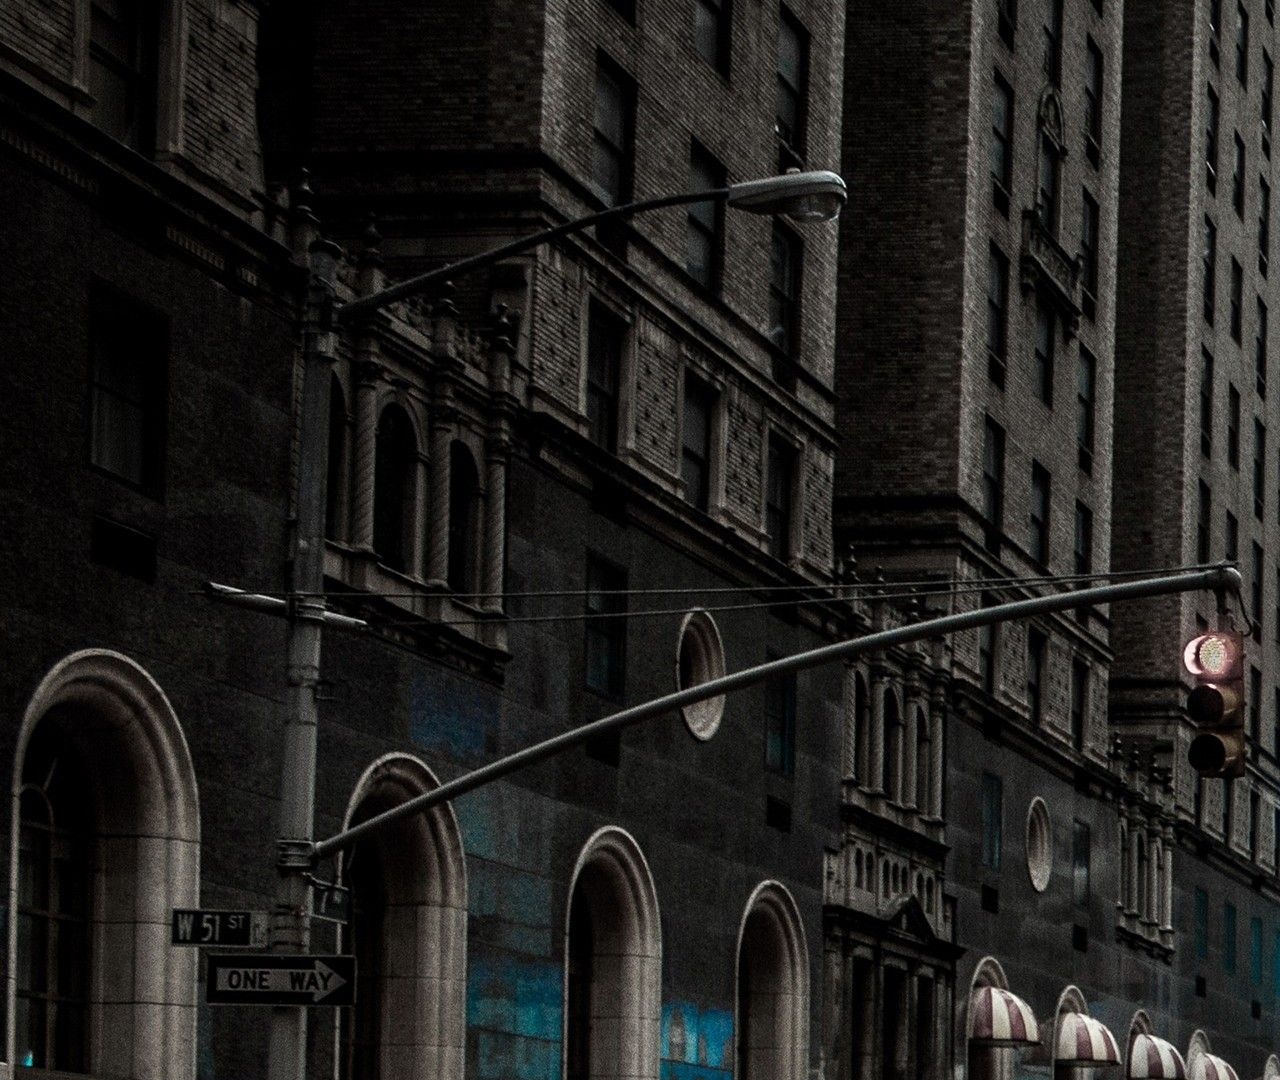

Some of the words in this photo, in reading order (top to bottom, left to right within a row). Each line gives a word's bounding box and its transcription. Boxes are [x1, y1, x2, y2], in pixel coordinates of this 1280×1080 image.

[177, 913, 194, 941] W
[201, 913, 221, 942] 51
[227, 914, 246, 930] ST
[228, 970, 271, 990] ONE
[288, 972, 333, 992] WAY
